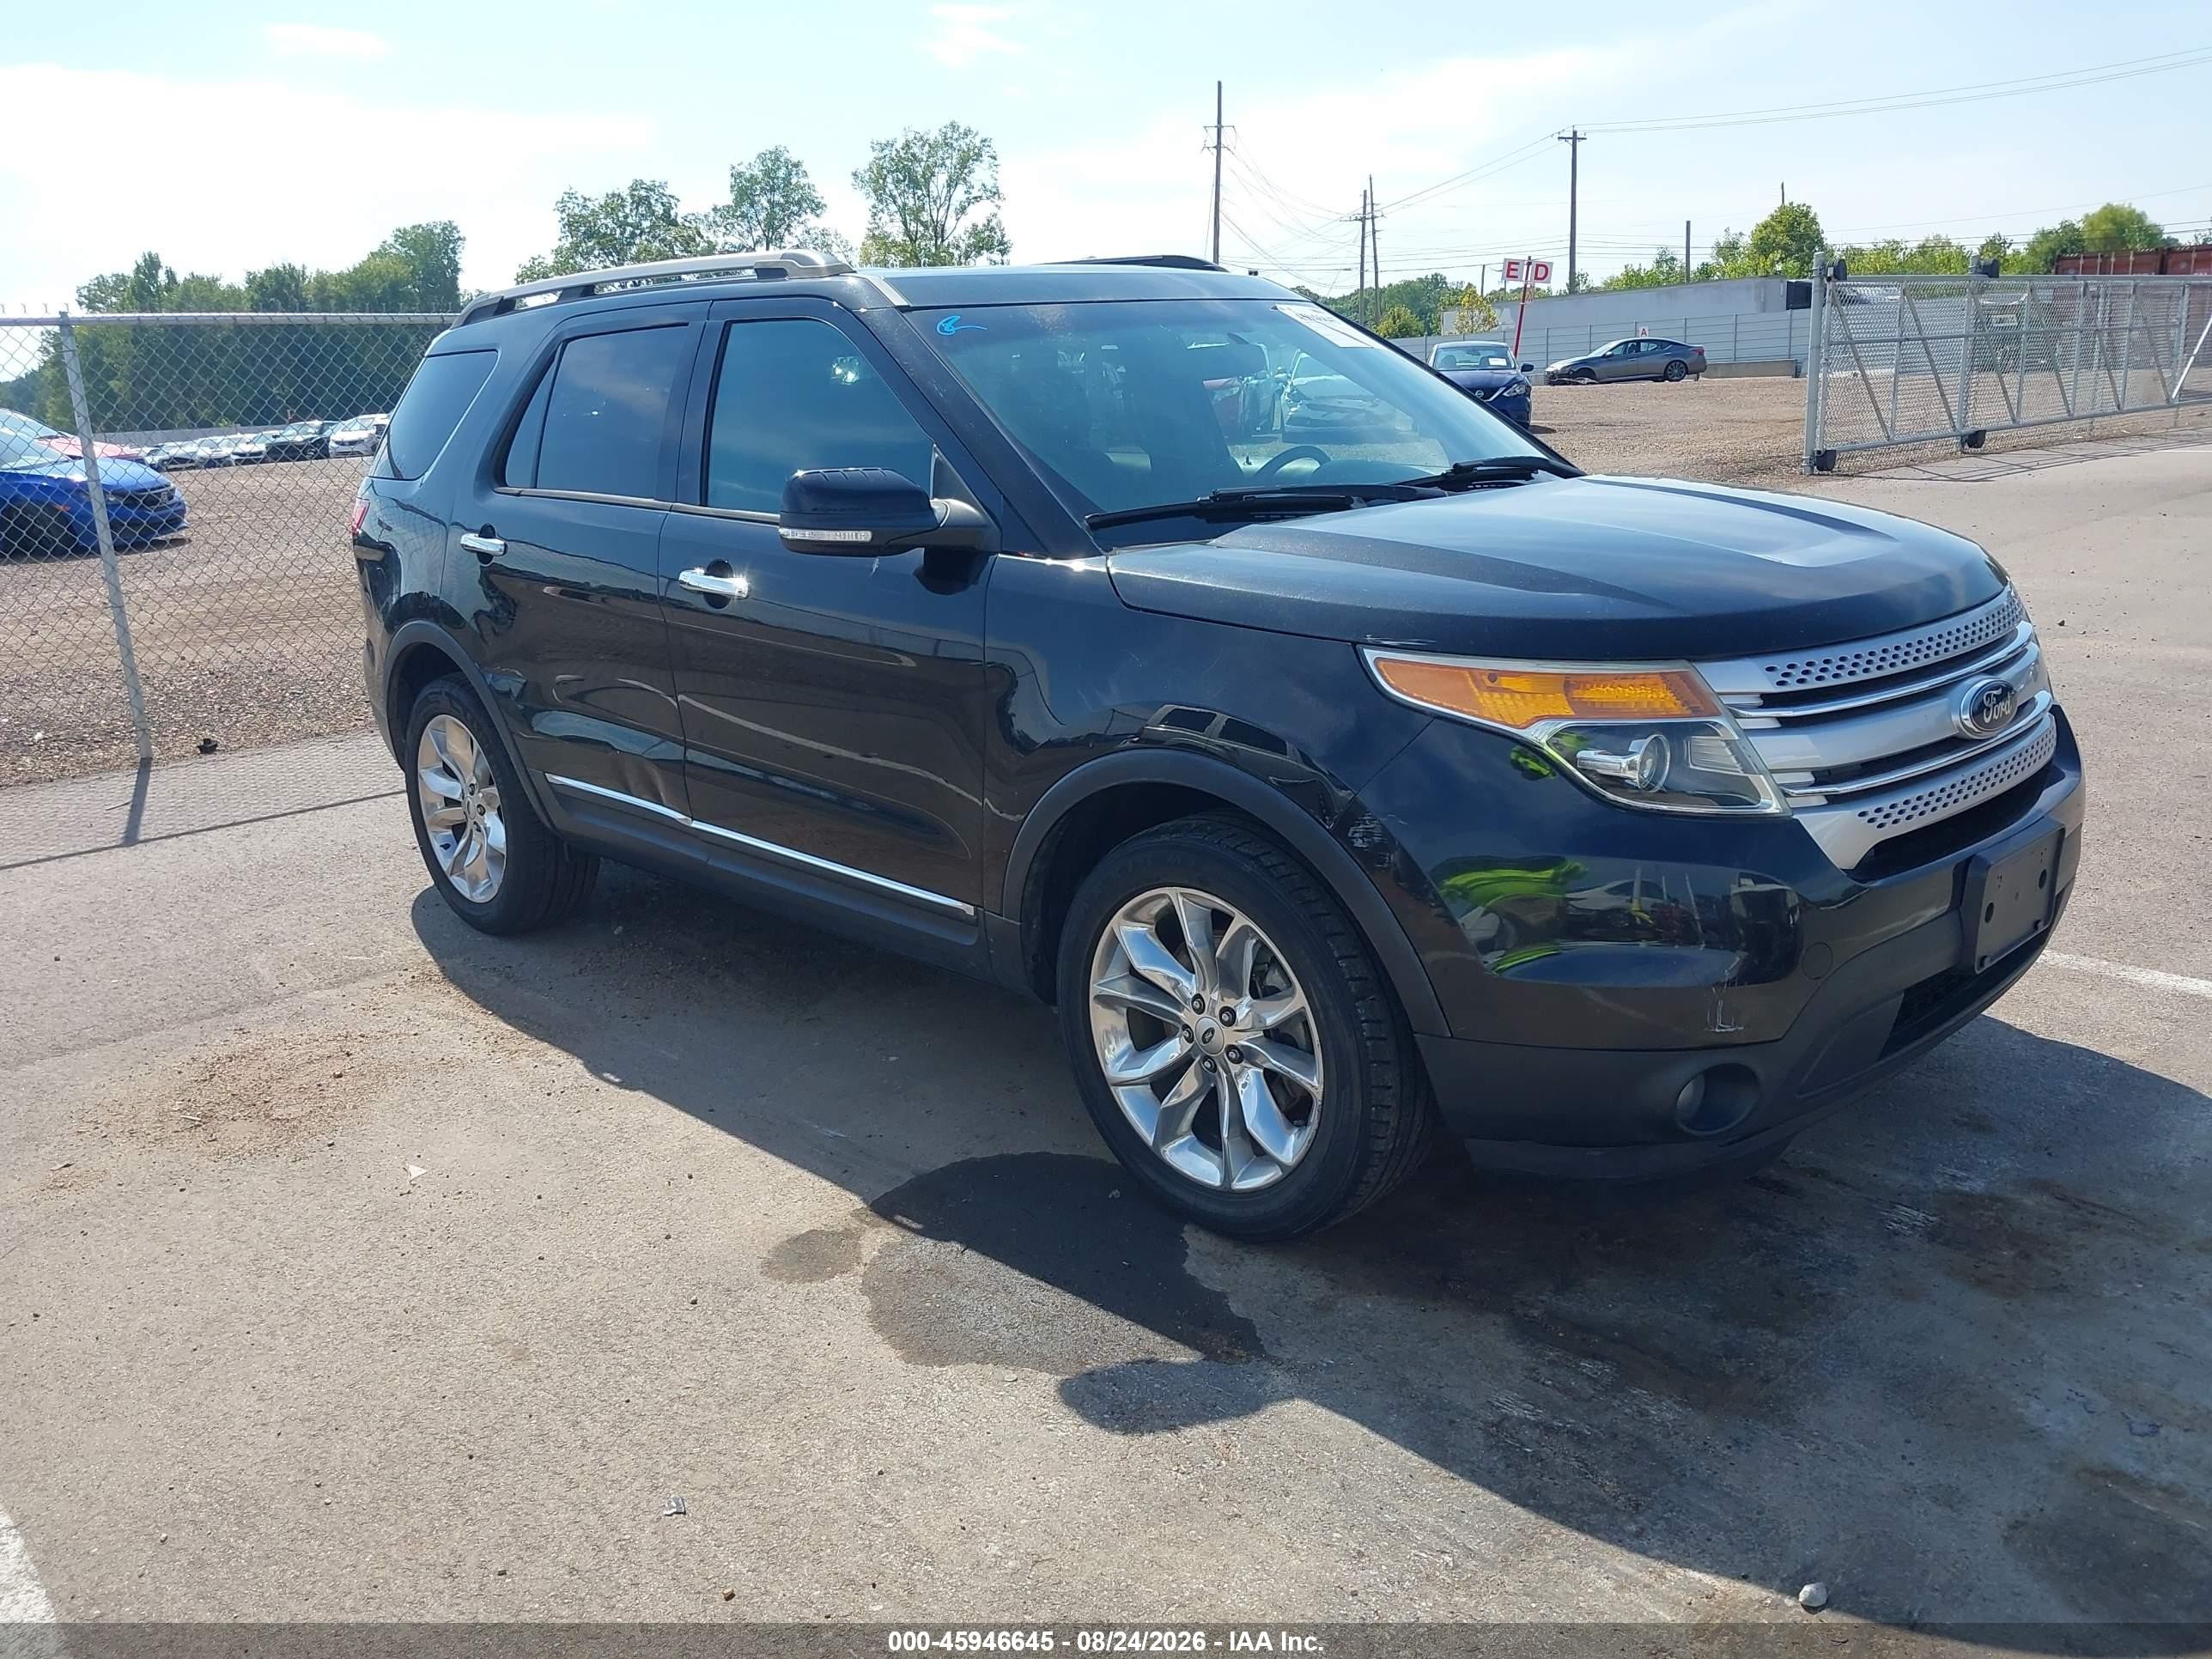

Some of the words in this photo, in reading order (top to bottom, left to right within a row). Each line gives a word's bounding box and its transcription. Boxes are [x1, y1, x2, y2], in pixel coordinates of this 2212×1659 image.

[1506, 261, 1520, 279] E
[1534, 264, 1549, 281] D
[1641, 328, 1647, 337] A
[1984, 687, 2011, 723] Ford
